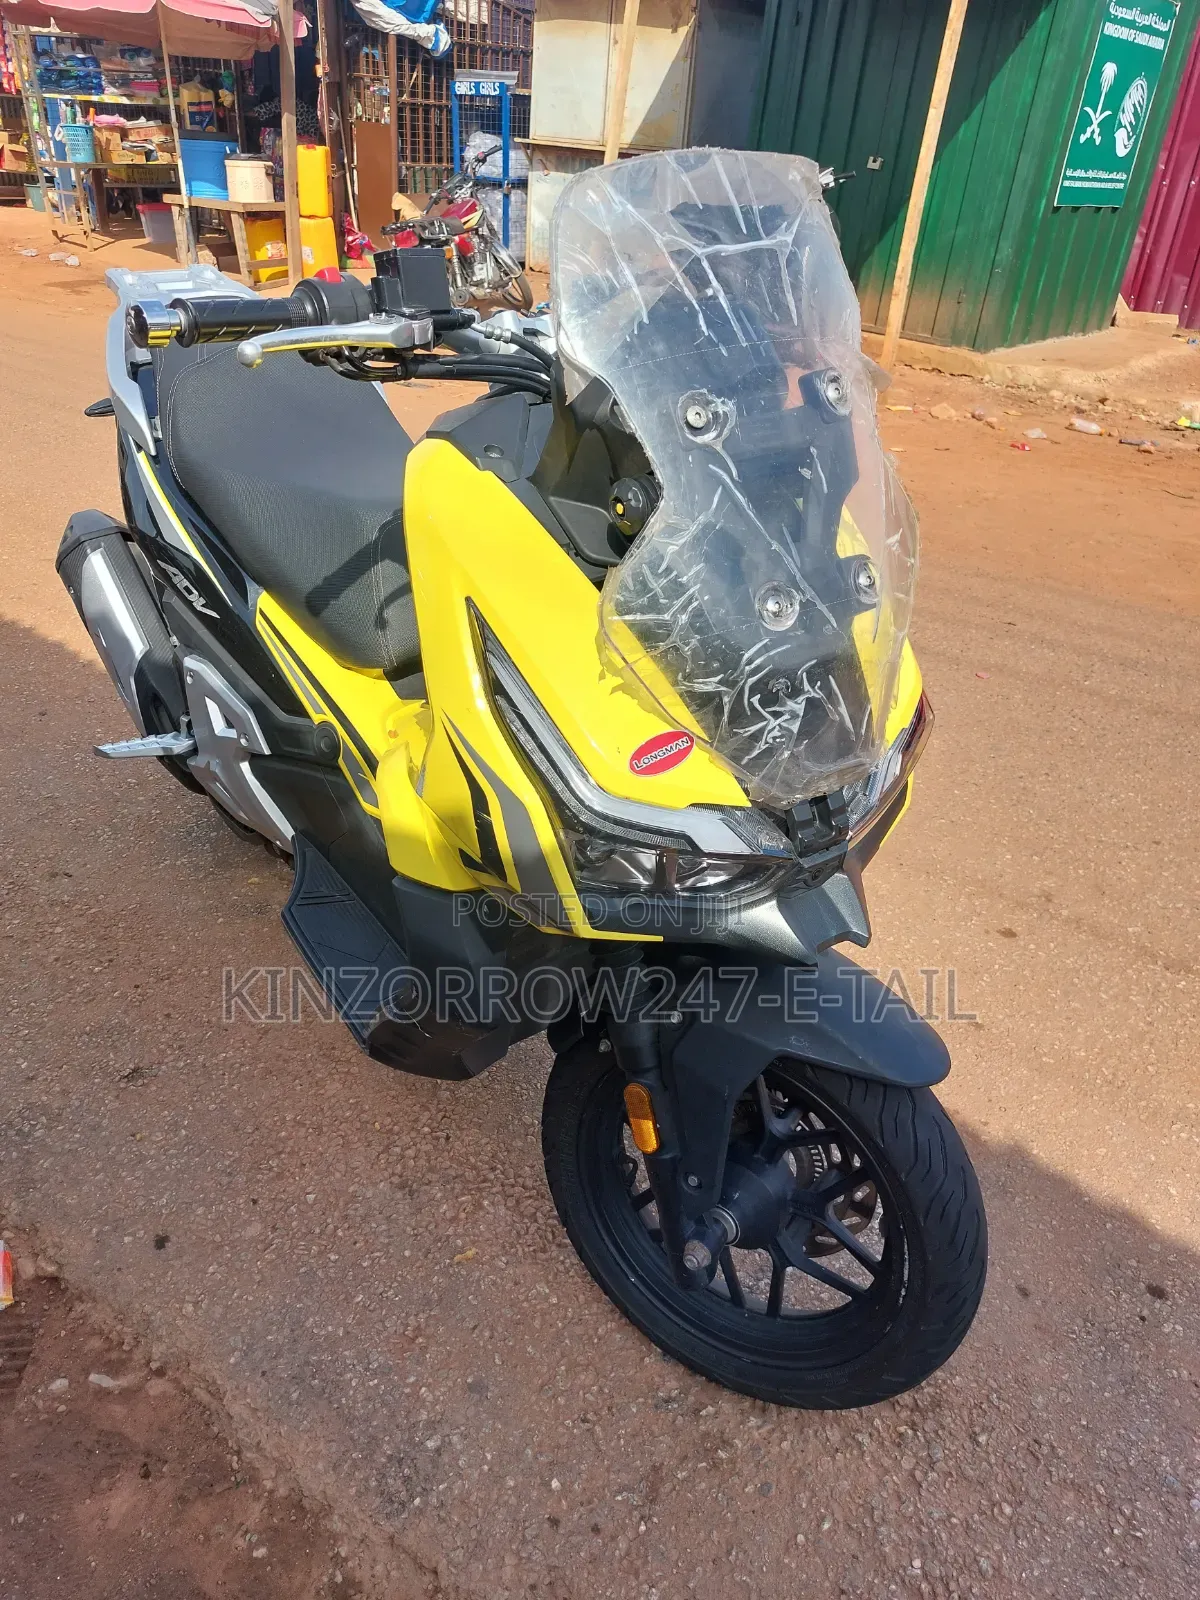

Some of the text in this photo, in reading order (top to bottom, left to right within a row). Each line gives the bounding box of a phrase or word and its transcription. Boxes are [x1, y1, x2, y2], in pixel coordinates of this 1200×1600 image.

[1103, 21, 1129, 40] KINGDOM
[1128, 28, 1136, 41] OF
[1134, 31, 1150, 46] SAUDI
[455, 82, 500, 95] GIRLS GIRLS
[156, 559, 220, 619] ADV
[633, 736, 691, 770] LONGMAN
